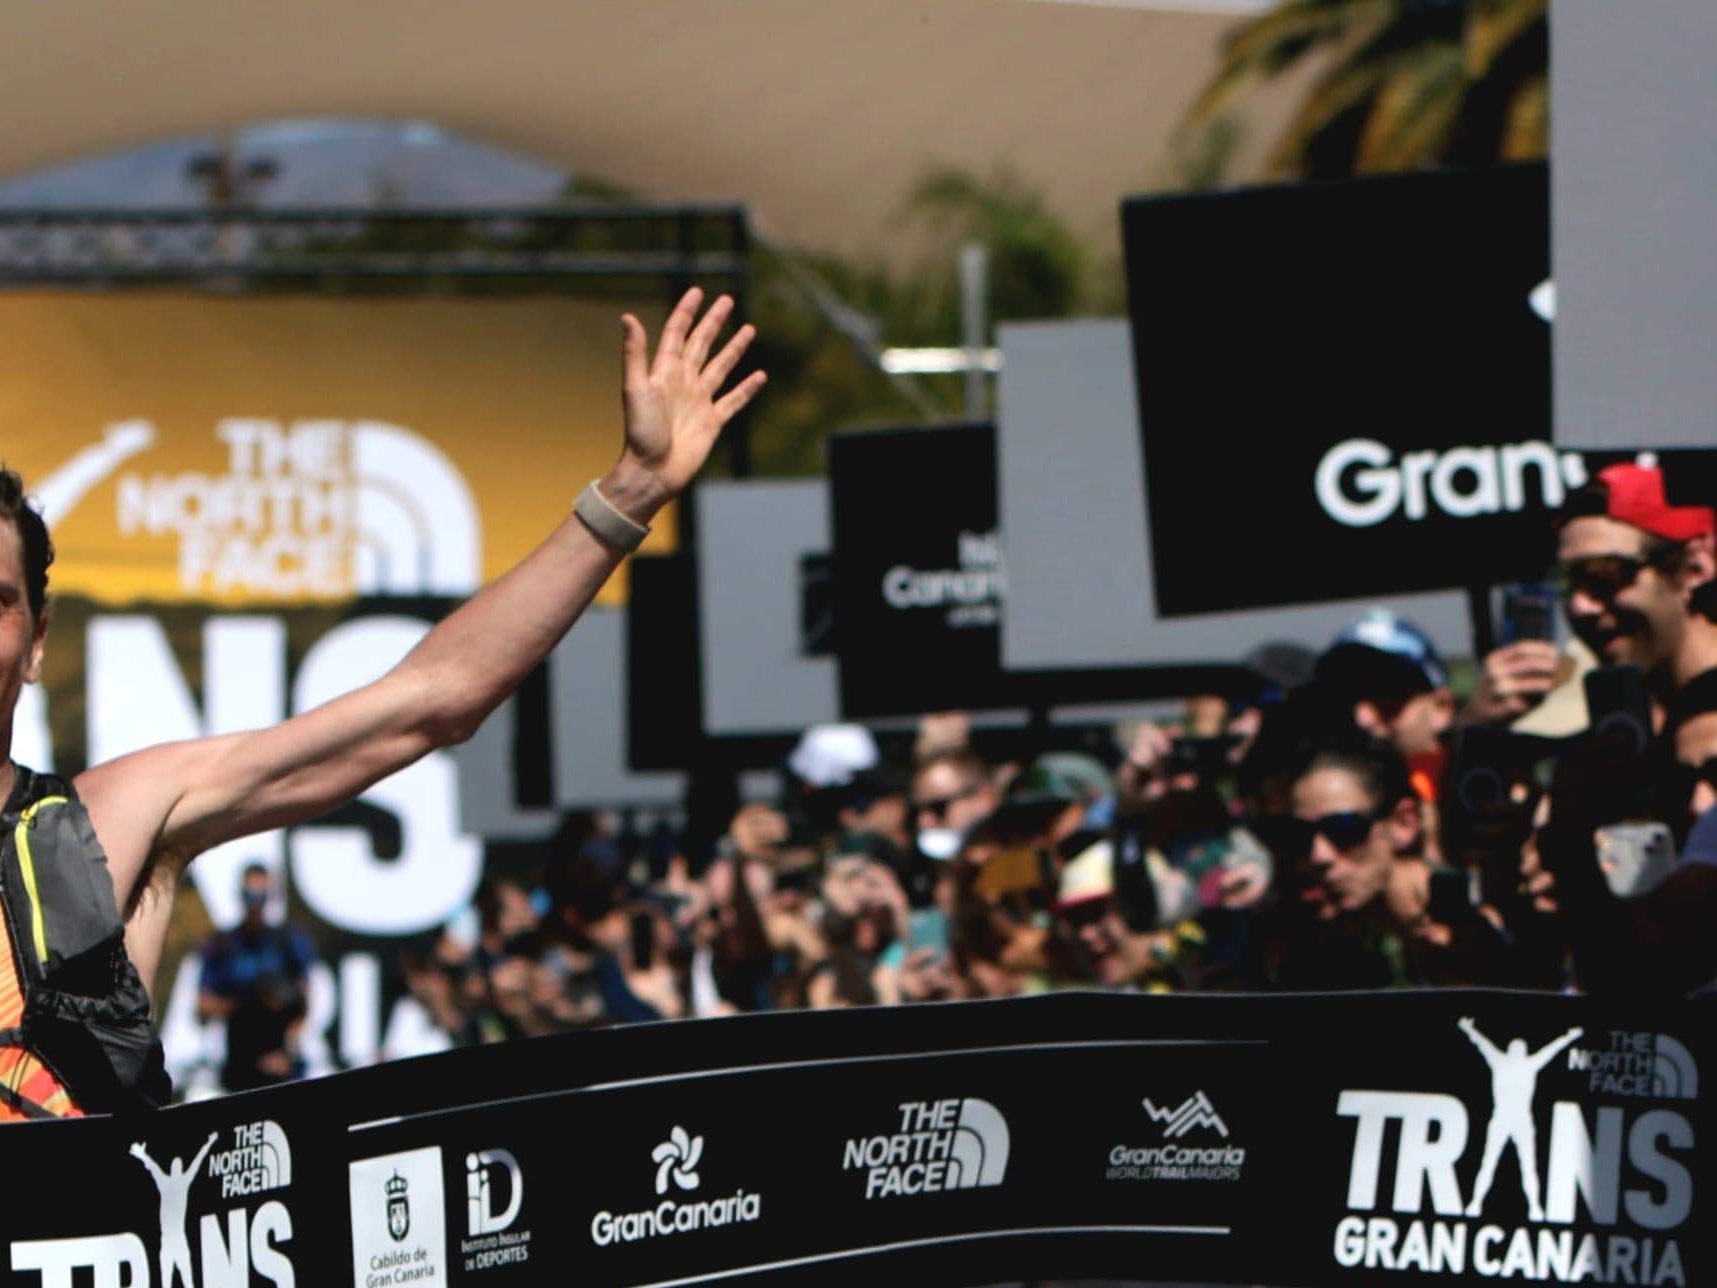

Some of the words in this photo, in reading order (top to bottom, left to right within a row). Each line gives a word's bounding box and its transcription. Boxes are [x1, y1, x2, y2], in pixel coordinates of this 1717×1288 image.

[217, 420, 346, 478] THE
[117, 474, 348, 537] NORTH
[178, 534, 348, 595] FACE
[1609, 1031, 1652, 1053] THE
[1568, 1048, 1652, 1072] NORTH
[1589, 1075, 1652, 1097] FACE
[898, 1099, 959, 1133] THE
[234, 1122, 262, 1146] THE
[209, 1146, 262, 1178] NORTH
[843, 1132, 953, 1171] NORTH
[1109, 1144, 1246, 1166] GranCanaria
[222, 1170, 262, 1199] FACE
[865, 1161, 947, 1200] FACE
[591, 1188, 761, 1247] GranCanaria
[370, 1249, 412, 1271] Cabildo
[413, 1245, 428, 1262] de
[476, 1244, 530, 1270] DEPORTES
[1333, 1216, 1467, 1275] GRAN
[1473, 1224, 1687, 1288] CANARIA
[393, 1262, 436, 1284] Canaria
